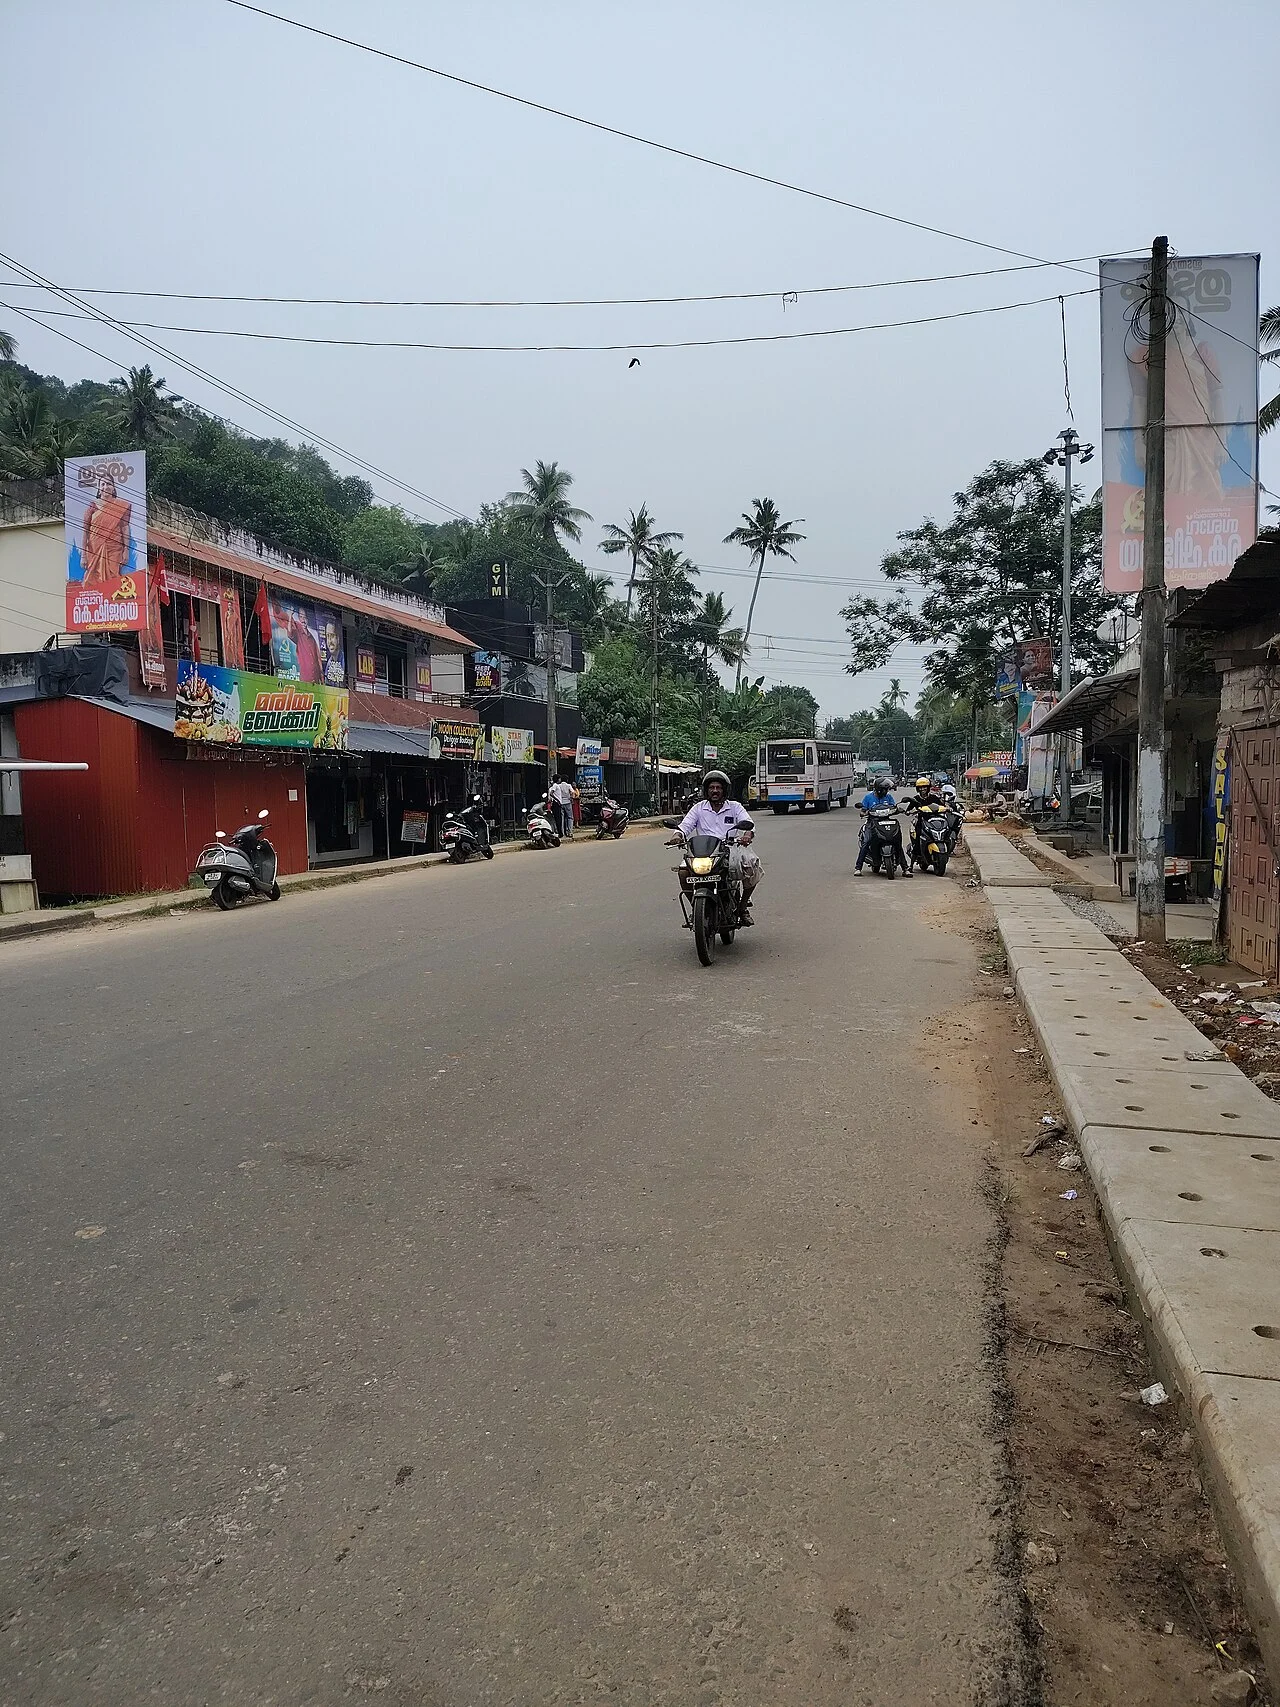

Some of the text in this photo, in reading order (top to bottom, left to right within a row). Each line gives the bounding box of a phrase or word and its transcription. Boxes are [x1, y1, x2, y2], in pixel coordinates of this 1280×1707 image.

[491, 563, 502, 597] GYM
[358, 654, 374, 675] LAB
[417, 667, 431, 686] LAB
[255, 685, 315, 711] മരിയ
[243, 702, 322, 731] ബേക്കറി
[508, 732, 522, 740] STAR
